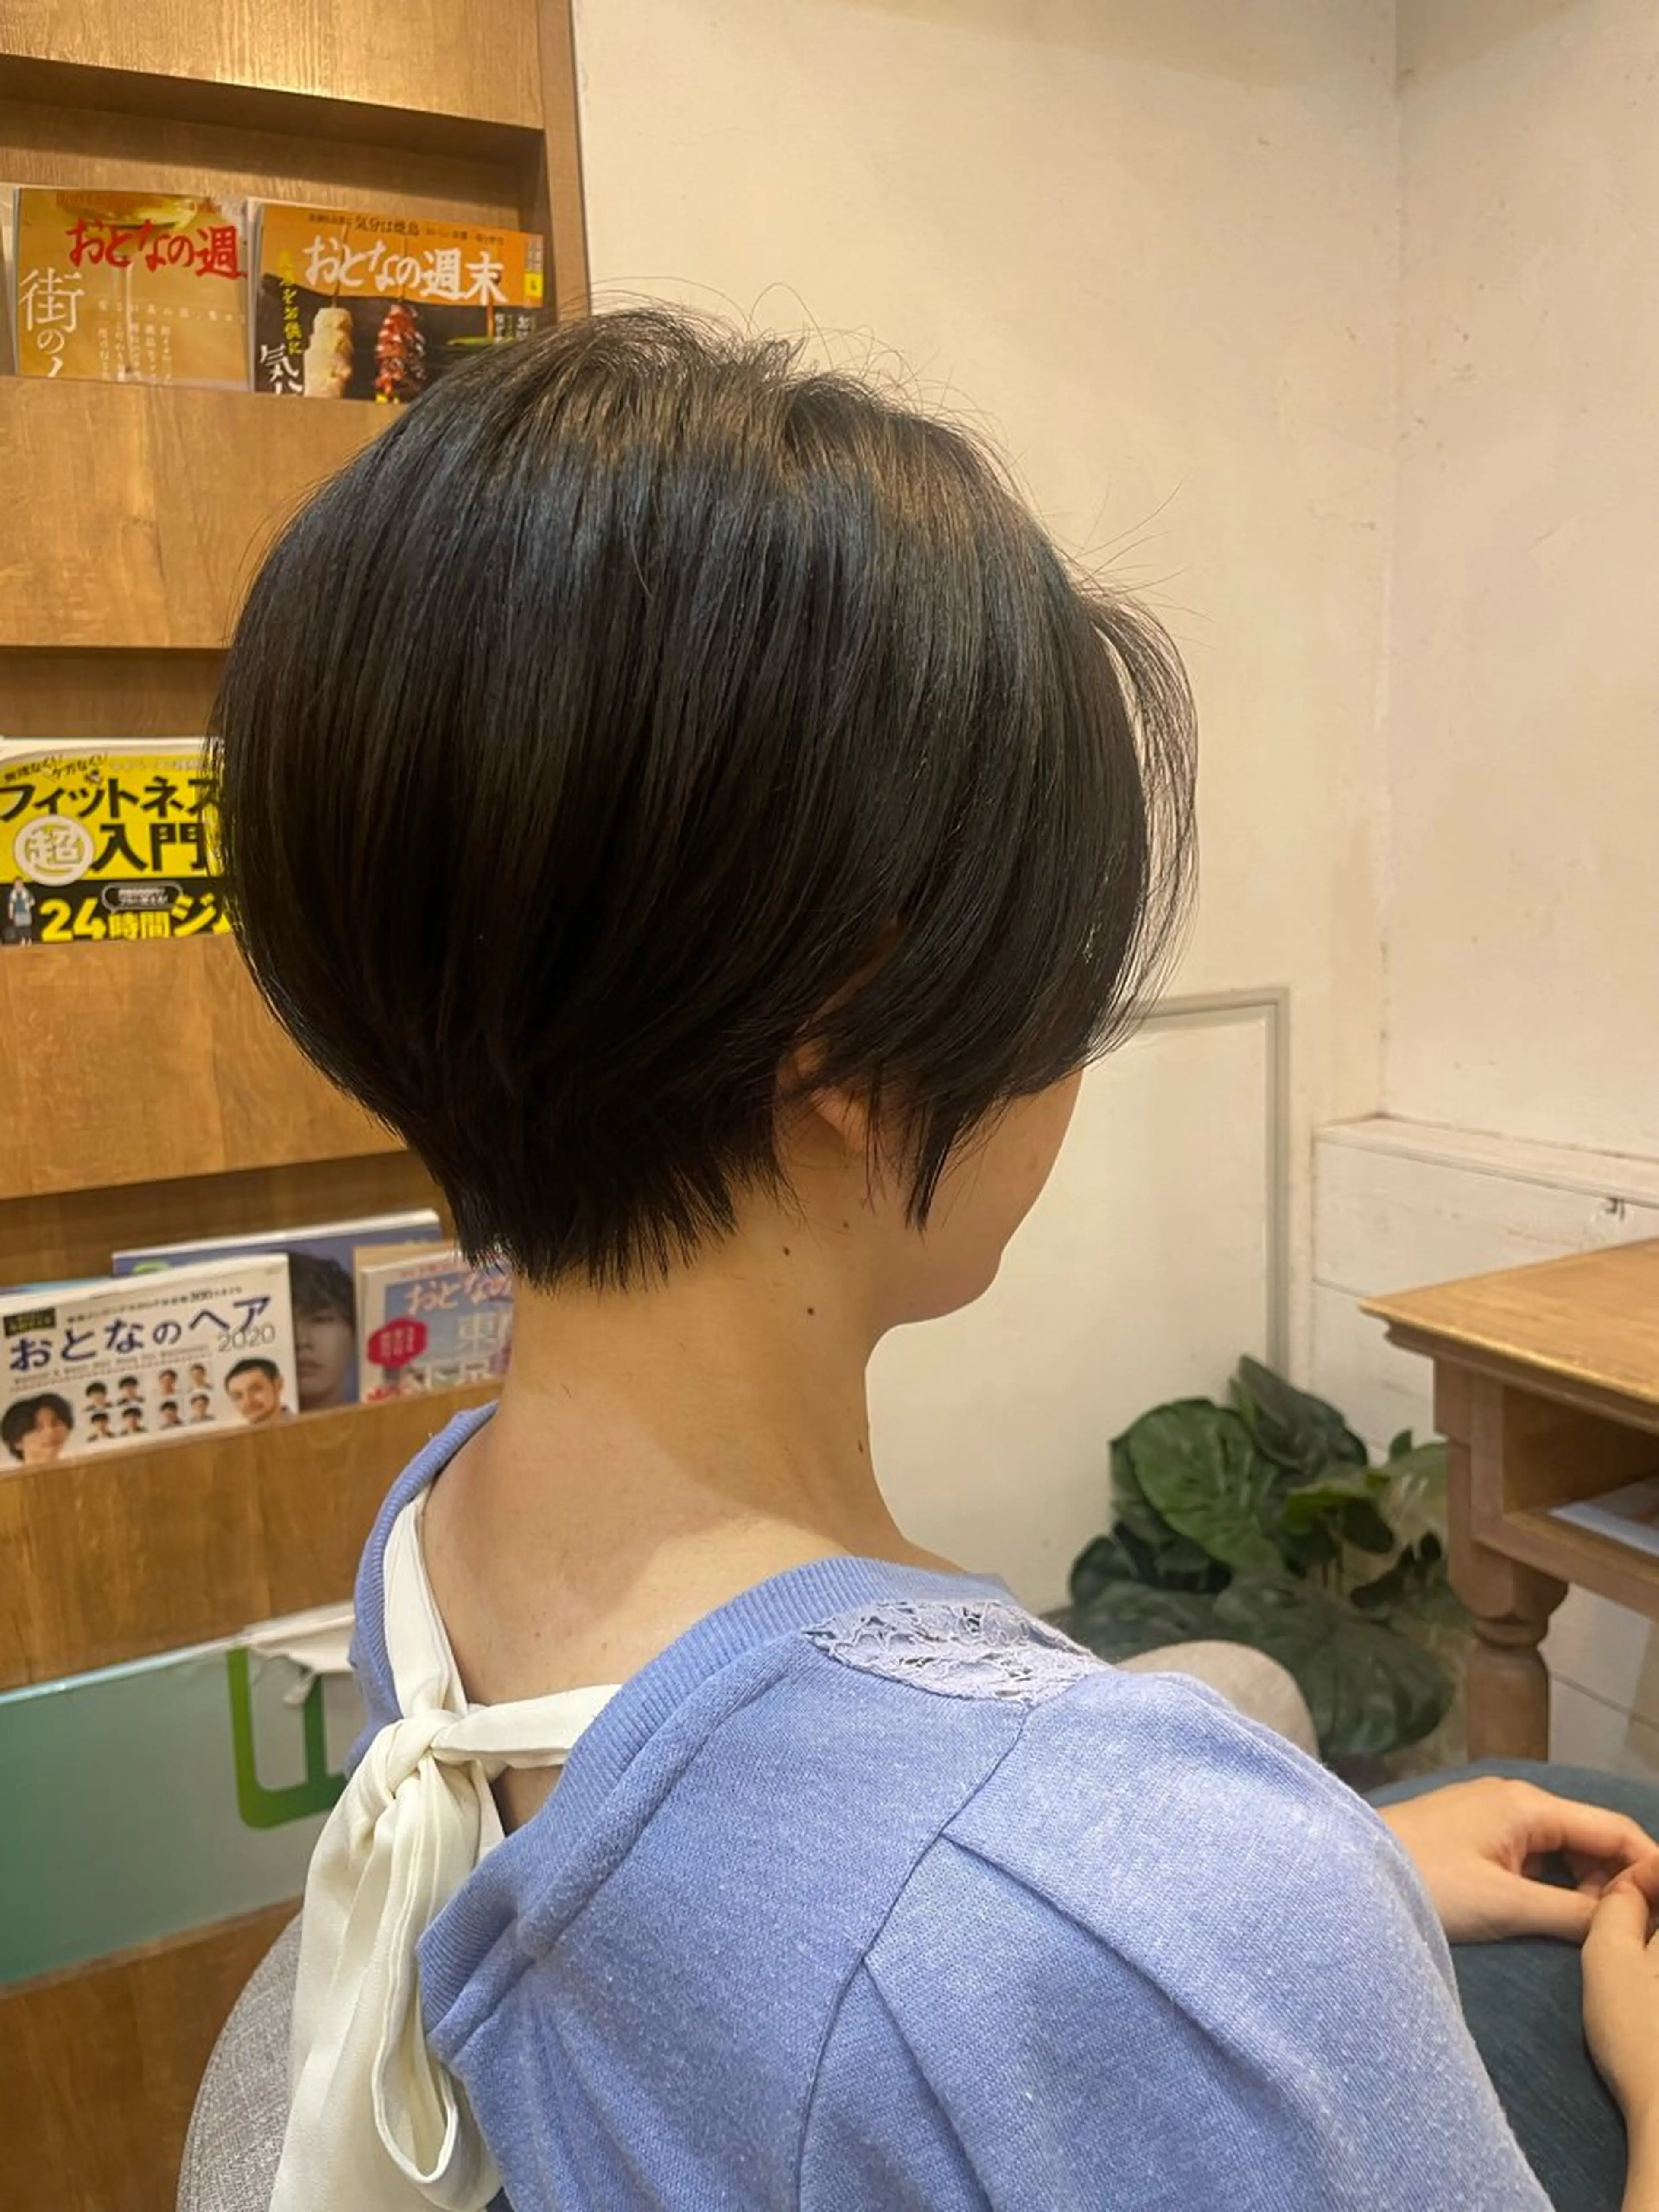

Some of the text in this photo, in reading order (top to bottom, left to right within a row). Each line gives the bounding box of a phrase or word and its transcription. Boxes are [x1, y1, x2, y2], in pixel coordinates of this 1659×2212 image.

[66, 218, 248, 280] おとなの週
[303, 234, 507, 306] おとなの週末
[10, 1297, 270, 1372] おとなのヘア
[217, 1321, 276, 1353] 2020
